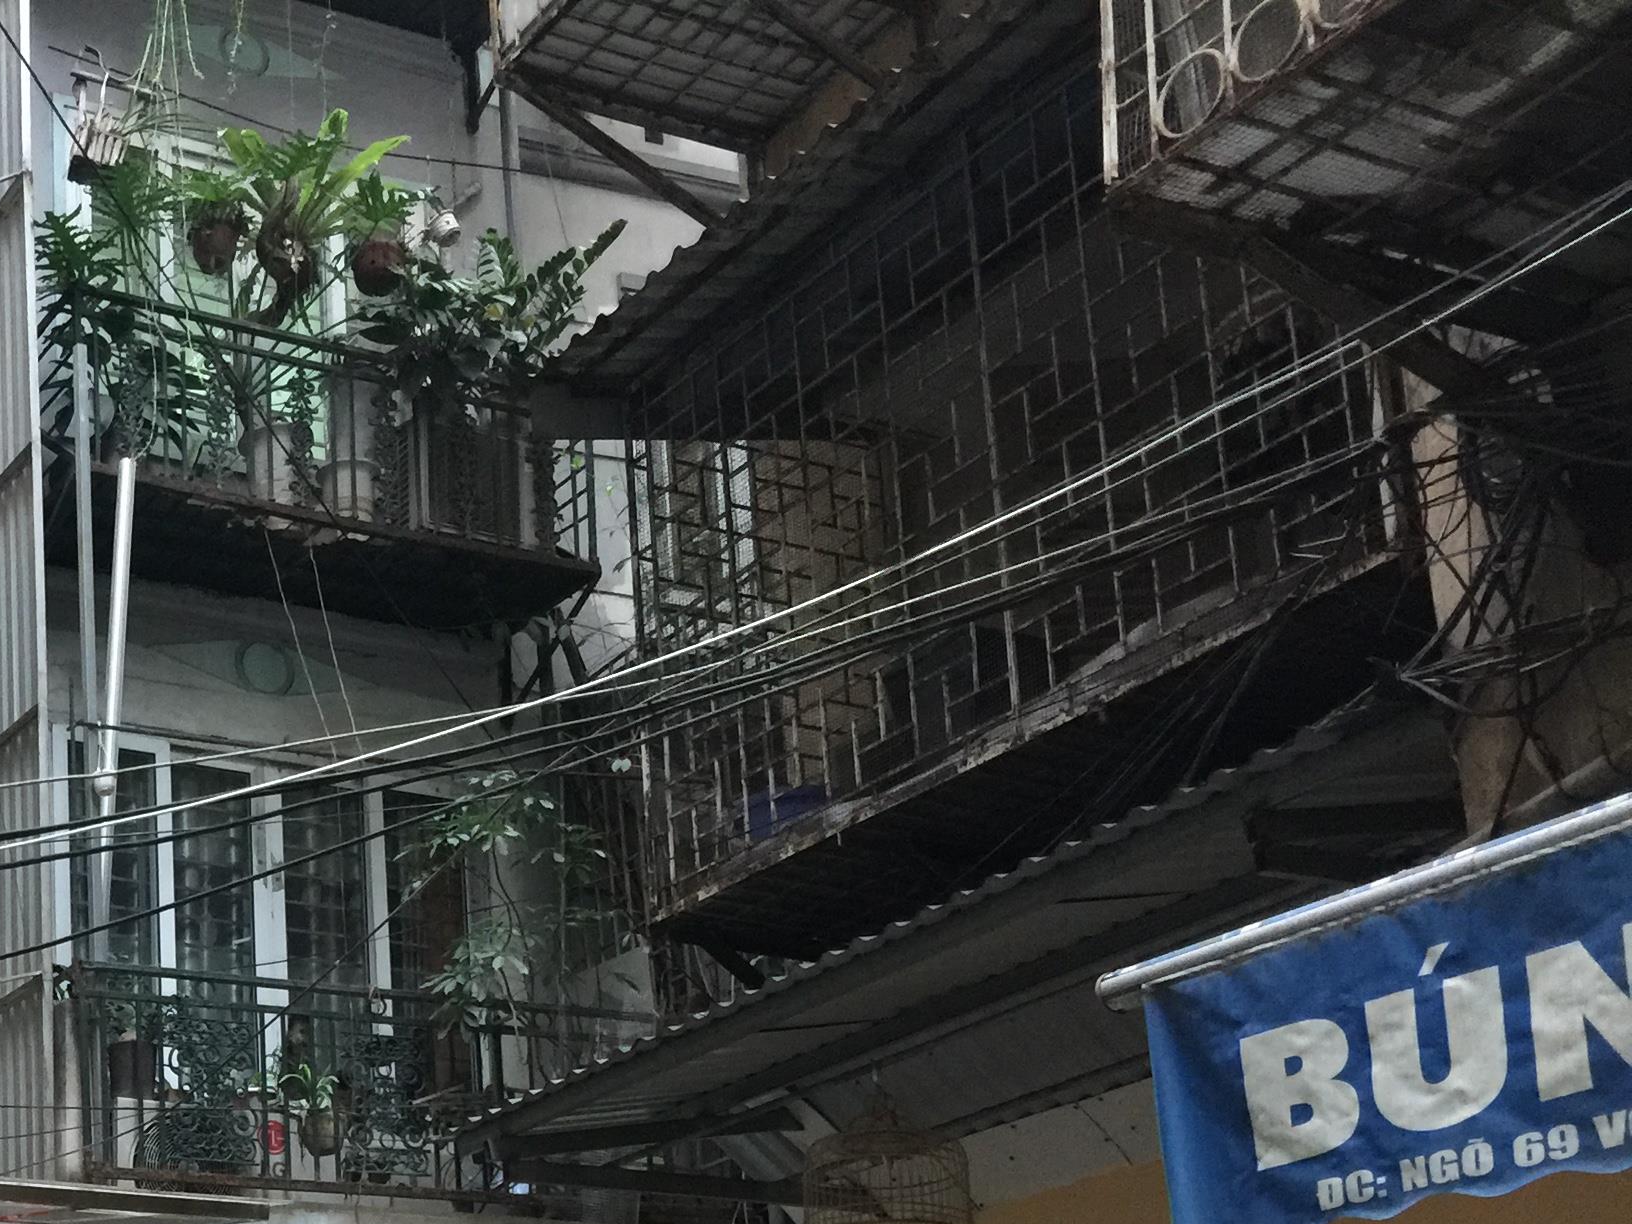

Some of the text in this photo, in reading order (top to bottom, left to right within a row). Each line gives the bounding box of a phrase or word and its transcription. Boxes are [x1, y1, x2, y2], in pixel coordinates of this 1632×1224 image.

[1239, 922, 1632, 1171] BÚN
[1316, 1109, 1632, 1212] ĐC: NGÕ 69 V
